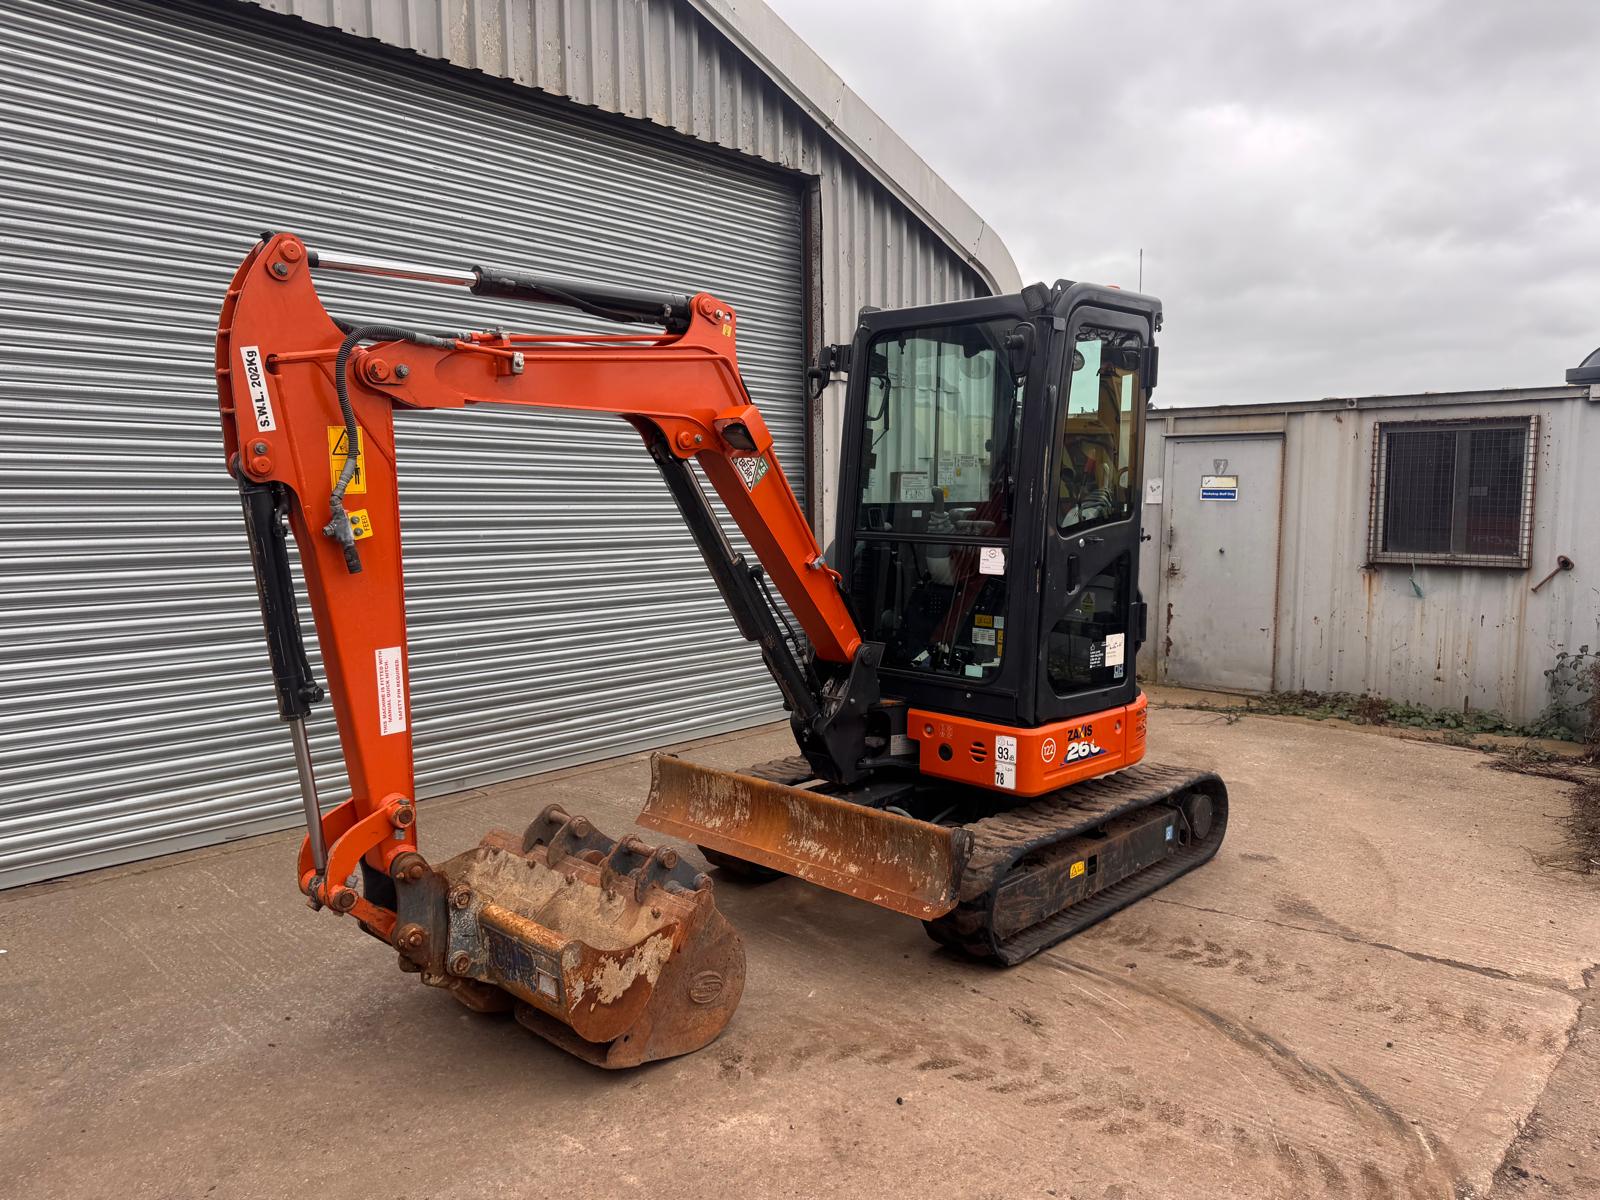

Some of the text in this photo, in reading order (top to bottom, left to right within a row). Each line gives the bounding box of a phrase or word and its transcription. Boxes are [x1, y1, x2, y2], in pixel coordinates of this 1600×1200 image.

[246, 350, 270, 427] S.W.L. 202Kg
[361, 515, 370, 531] FEED
[1067, 724, 1093, 742] ZAXIS
[998, 746, 1009, 760] 93
[1044, 745, 1054, 756] 122
[996, 772, 1004, 785] 78
